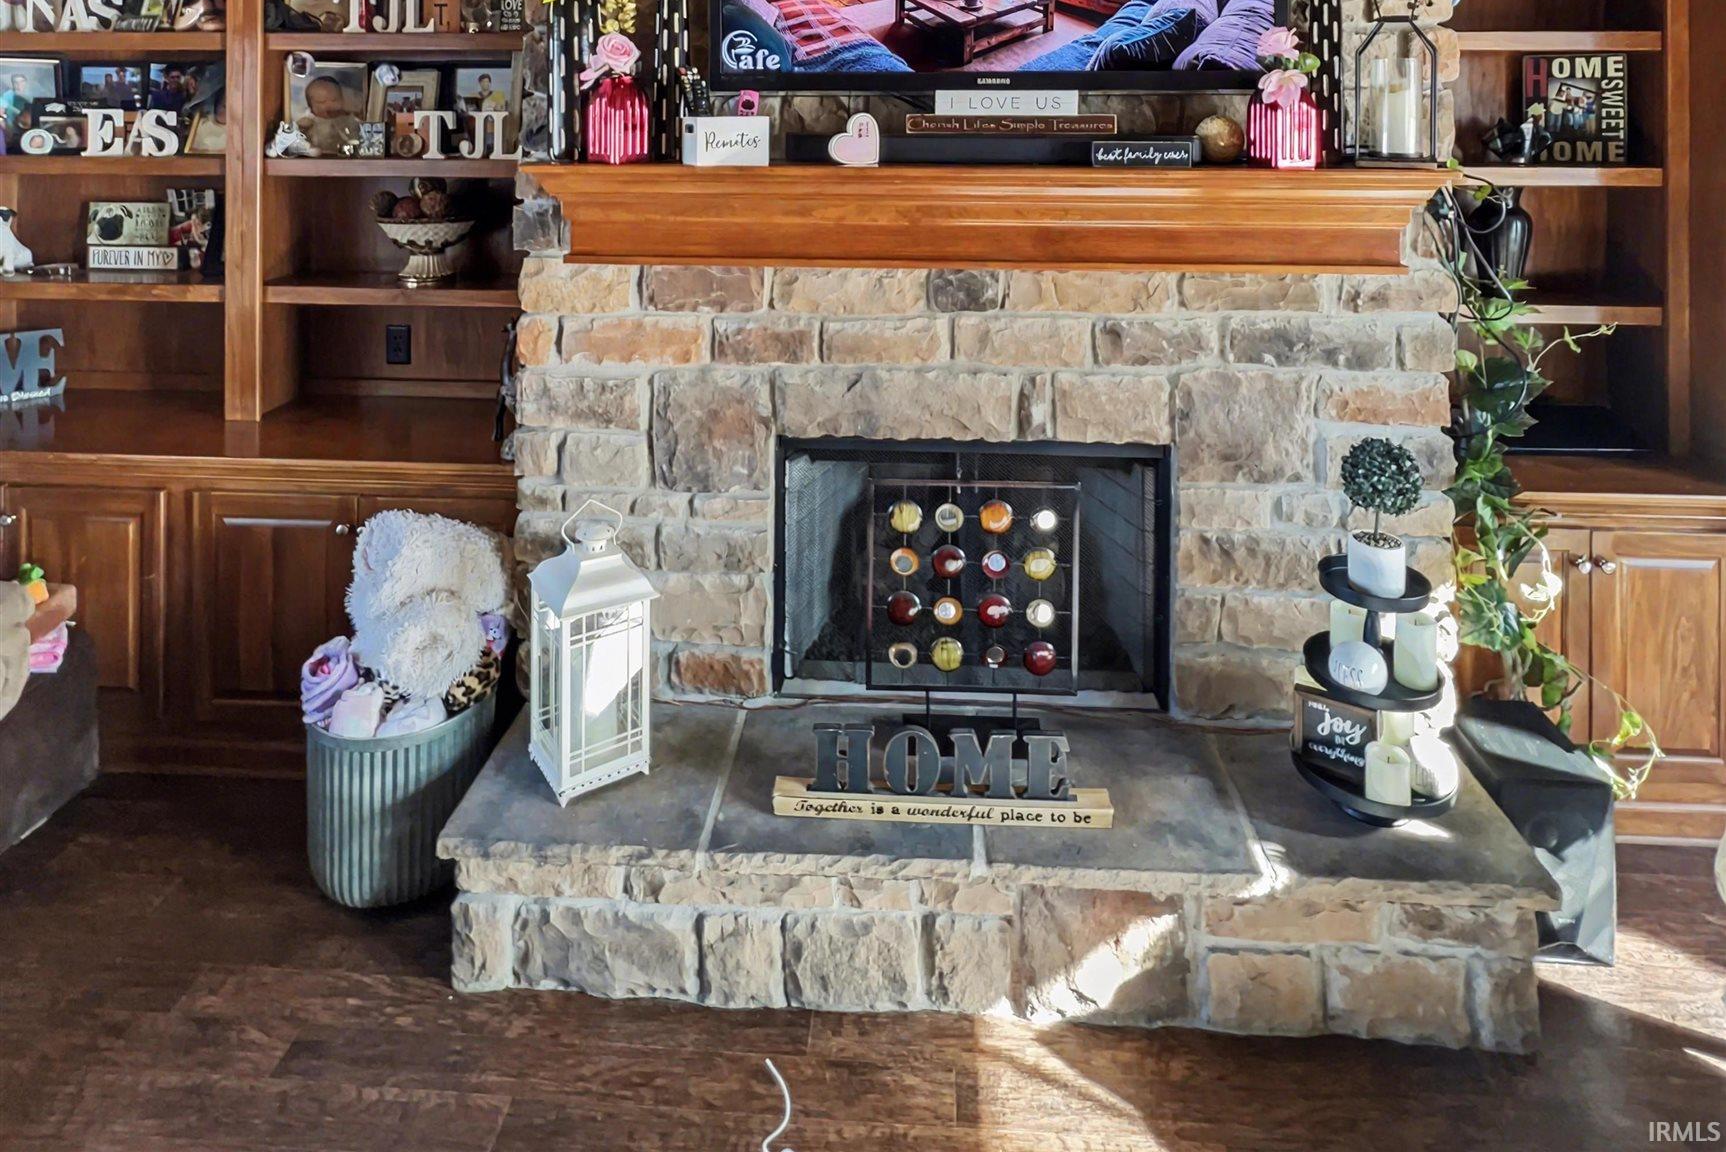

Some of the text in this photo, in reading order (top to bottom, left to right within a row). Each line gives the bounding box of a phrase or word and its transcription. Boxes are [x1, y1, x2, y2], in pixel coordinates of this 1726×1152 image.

[968, 96, 1021, 110] LOVE
[1036, 96, 1062, 110] US
[1601, 79, 1625, 139] SWEET
[413, 110, 523, 160] TJL
[1540, 141, 1625, 162] OME
[133, 248, 144, 265] IN
[807, 723, 1078, 801] HOME
[794, 800, 1092, 824] Together is a wonderful place to be
